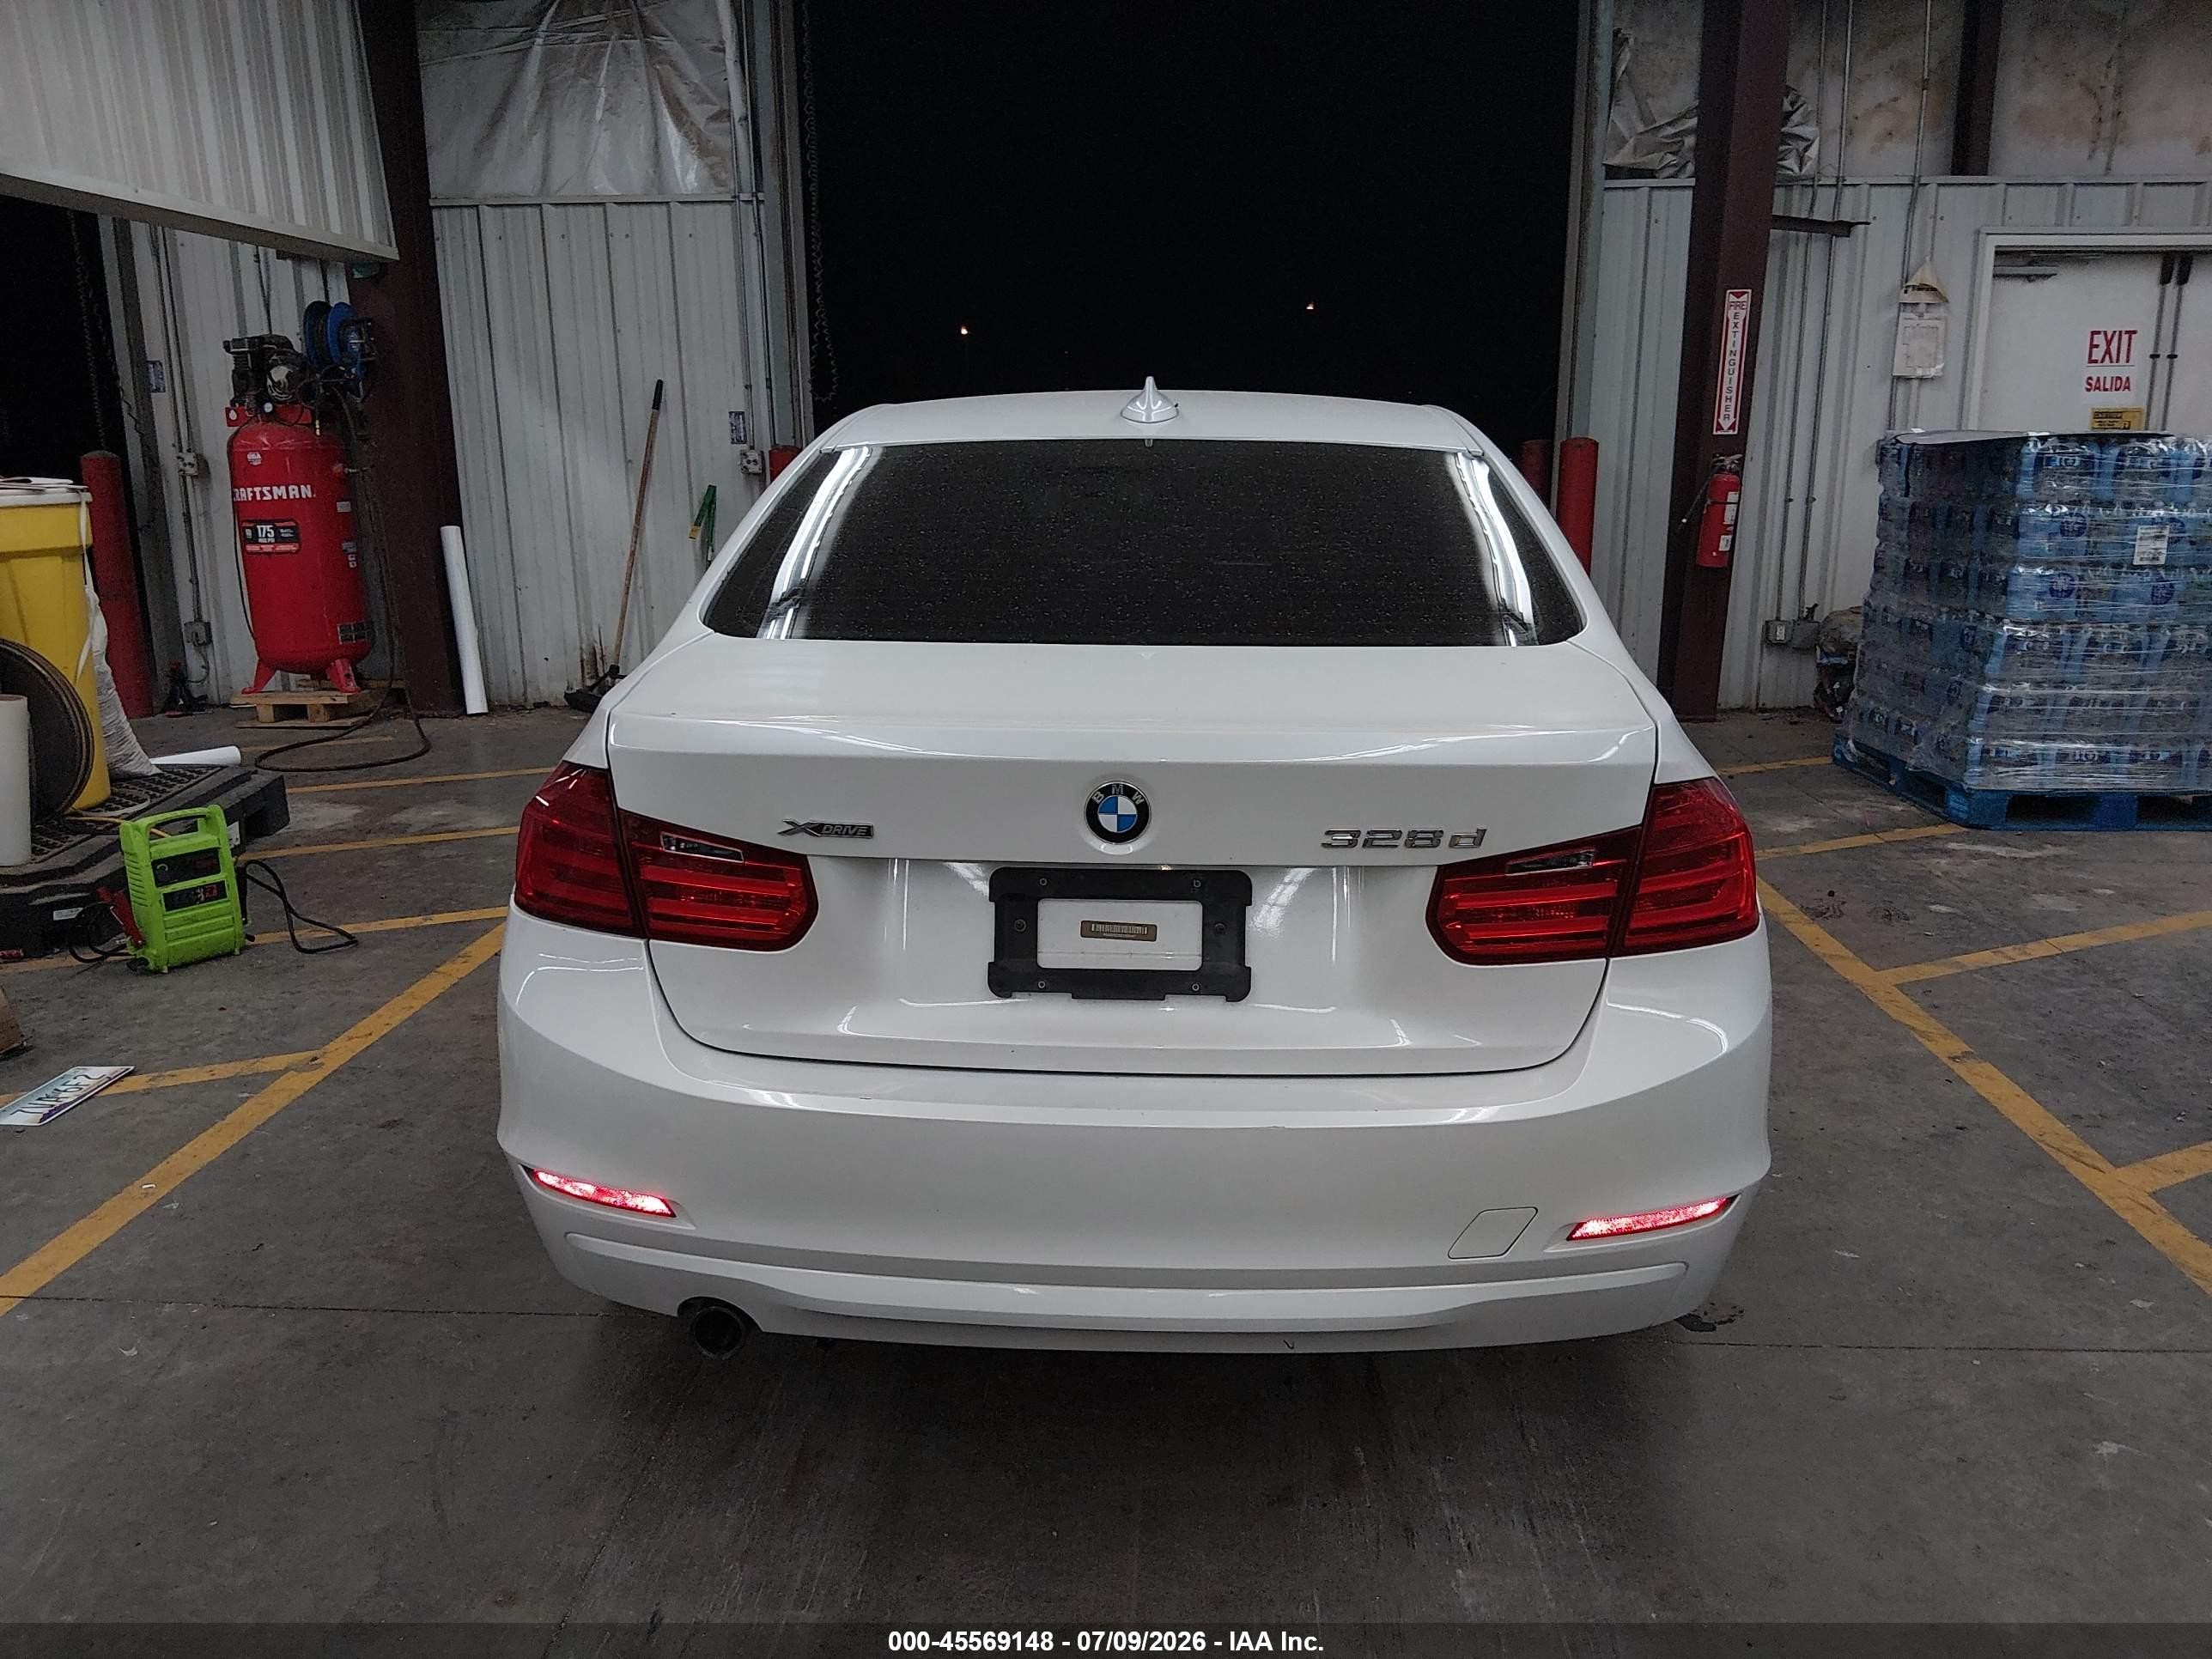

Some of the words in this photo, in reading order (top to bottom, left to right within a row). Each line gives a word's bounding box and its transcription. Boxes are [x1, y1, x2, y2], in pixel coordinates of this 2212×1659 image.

[1729, 301, 1747, 311] FIRE
[2087, 330, 2138, 364] EXIT
[1723, 312, 1740, 421] EXTINGUISHER
[2085, 376, 2131, 392] SALIDA
[233, 484, 313, 501] RAFTSMAN
[257, 525, 275, 538] 175
[1091, 784, 1145, 805] BMW
[1321, 828, 1487, 848] 328d
